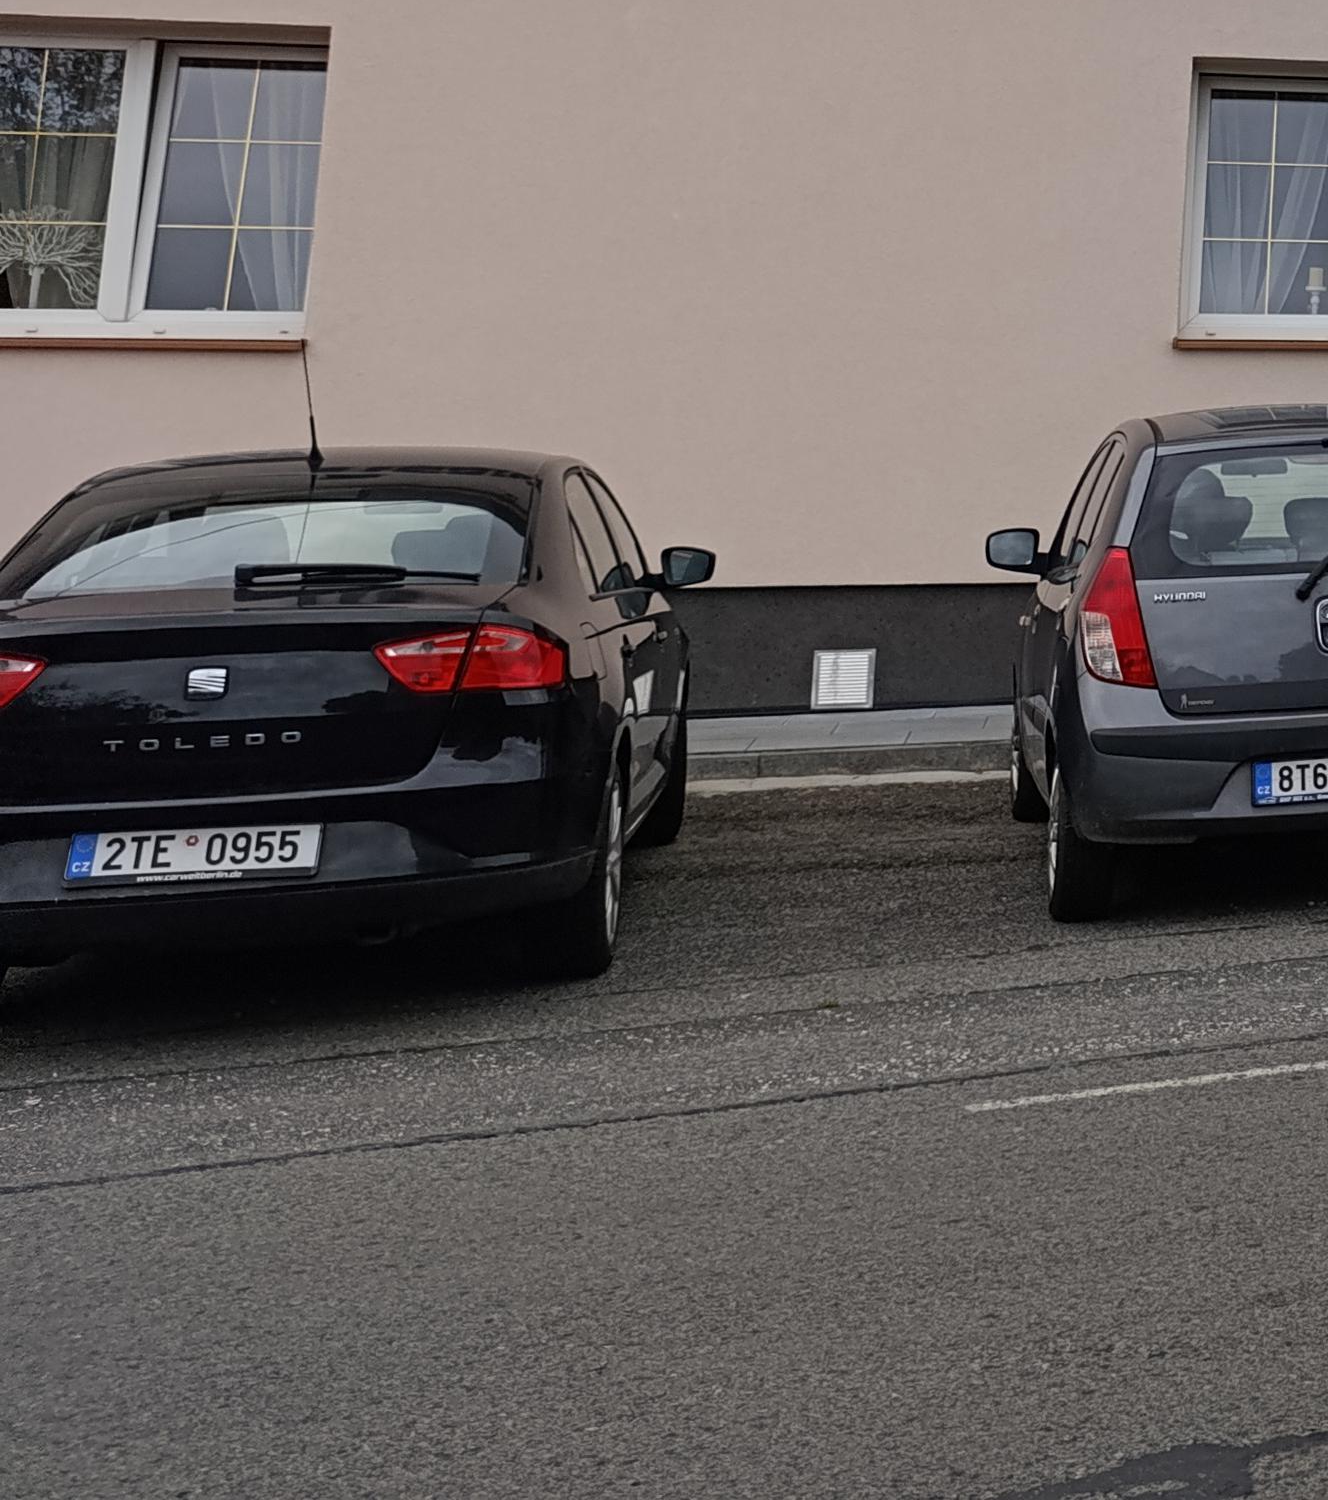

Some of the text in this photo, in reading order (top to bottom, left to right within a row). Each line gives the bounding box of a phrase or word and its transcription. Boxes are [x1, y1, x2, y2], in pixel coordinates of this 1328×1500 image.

[1153, 591, 1206, 602] HYUNDAI
[103, 731, 301, 752] TOLEDO
[1278, 763, 1328, 793] 8T6
[1257, 787, 1271, 795] CZ
[101, 830, 301, 871] 2TE 0955
[71, 861, 91, 873] CZ
